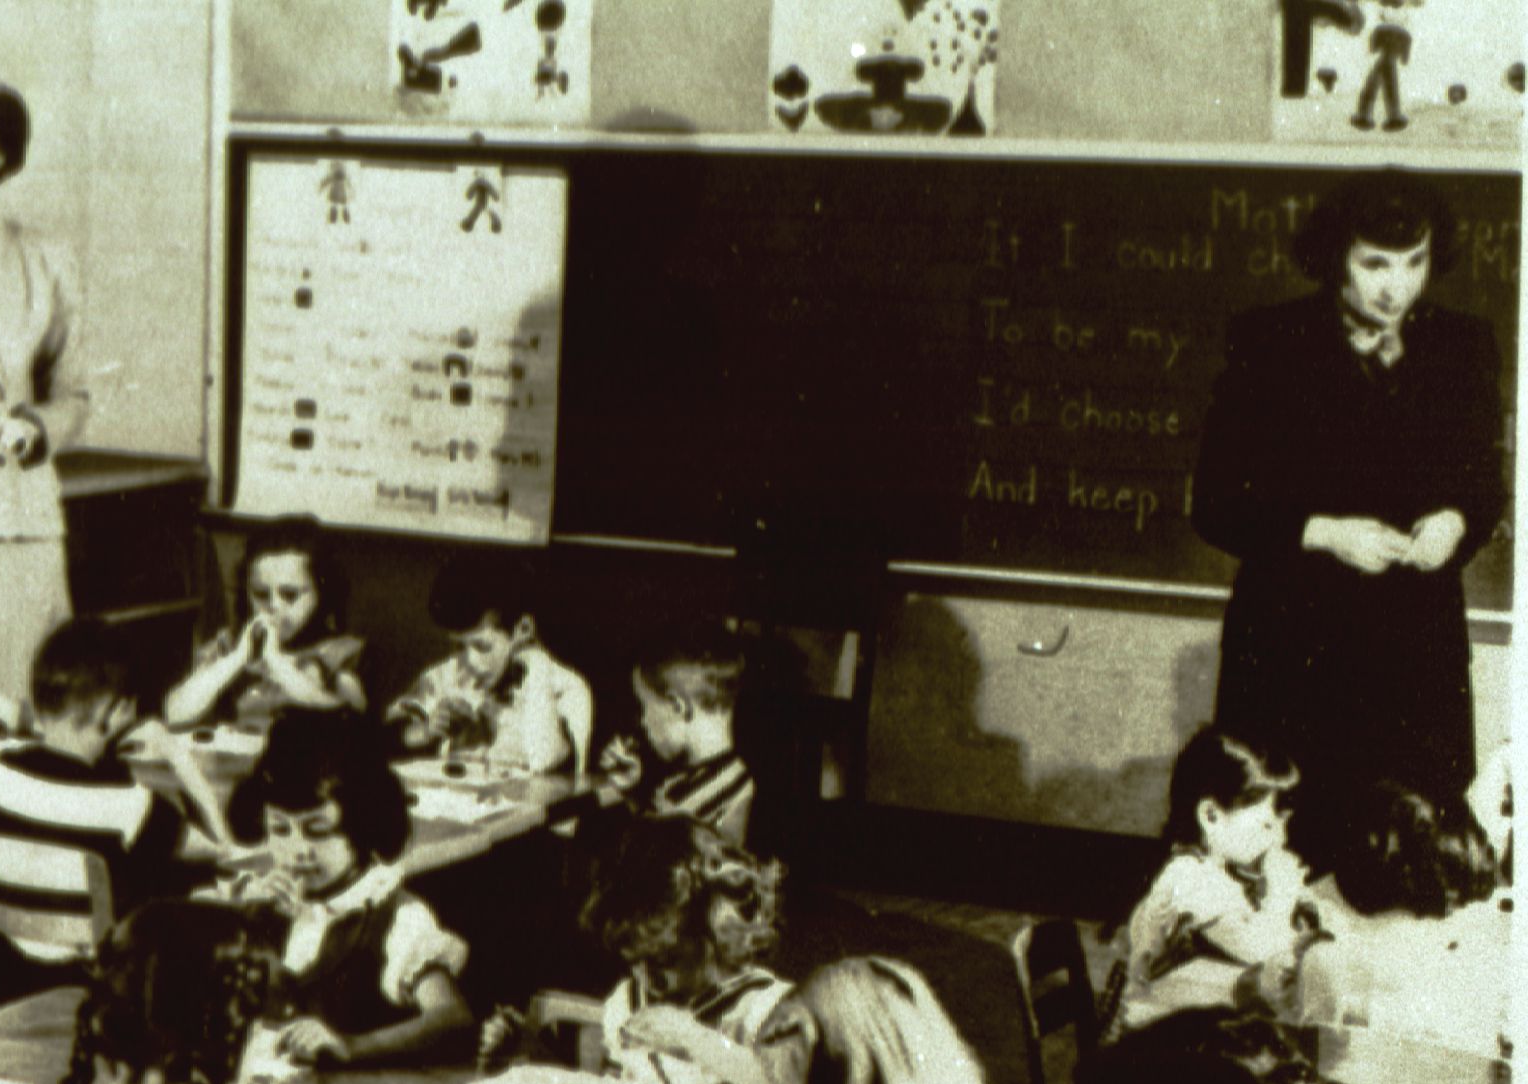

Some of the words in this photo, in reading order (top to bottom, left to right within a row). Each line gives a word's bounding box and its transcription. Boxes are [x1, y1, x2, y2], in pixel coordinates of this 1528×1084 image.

[1117, 234, 1213, 271] could
[980, 298, 1024, 343] To
[1053, 310, 1094, 351] be
[1128, 328, 1188, 369] my
[967, 459, 1038, 505] And
[1068, 470, 1159, 532] keep
